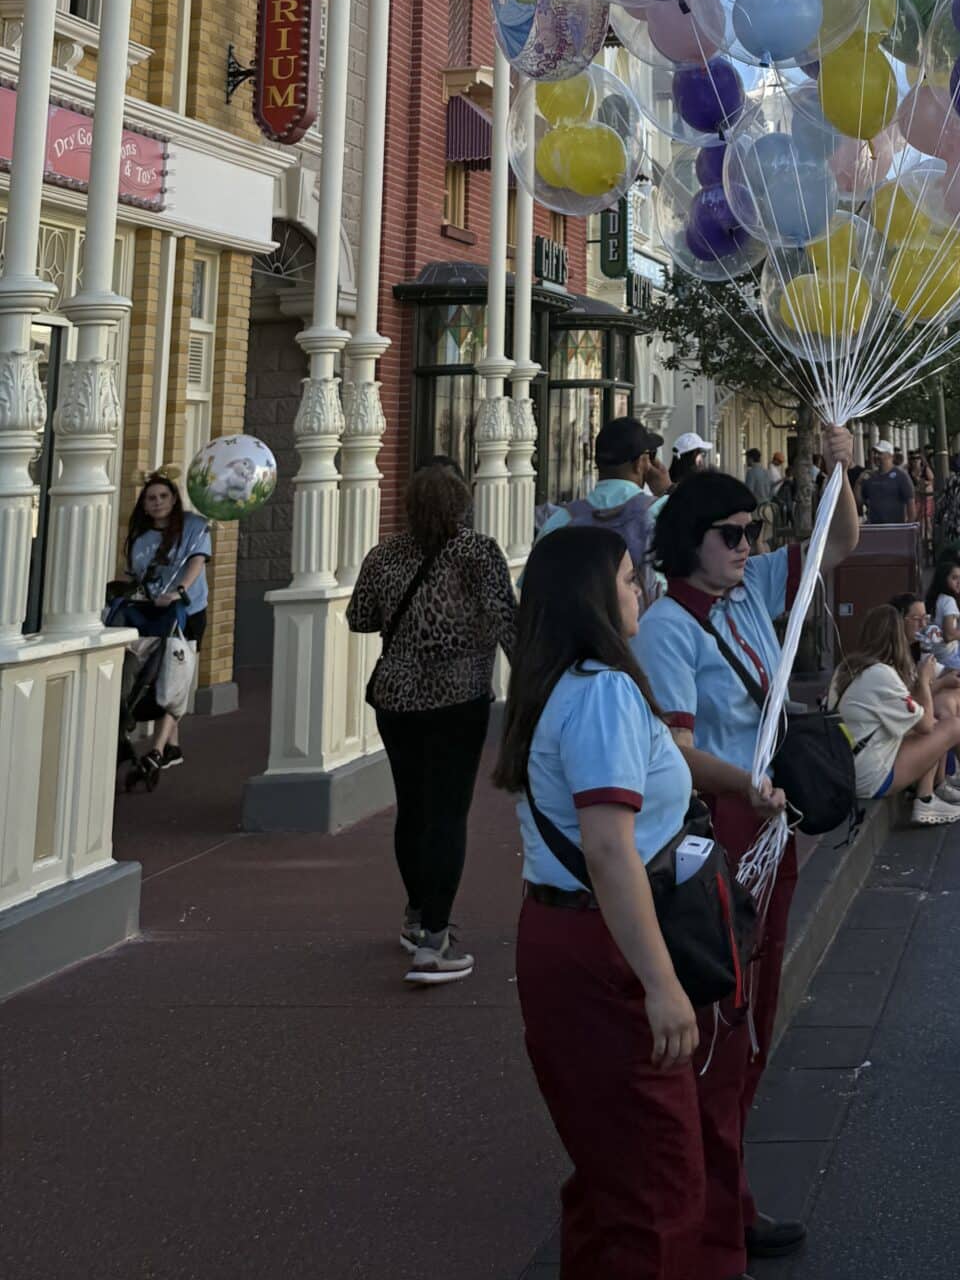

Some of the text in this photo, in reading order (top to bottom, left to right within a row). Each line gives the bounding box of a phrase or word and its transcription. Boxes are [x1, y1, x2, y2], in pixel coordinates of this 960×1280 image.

[54, 133, 75, 158] Dry
[124, 160, 157, 185] & Toys
[608, 212, 619, 261] DE
[542, 236, 569, 284] GIFTS
